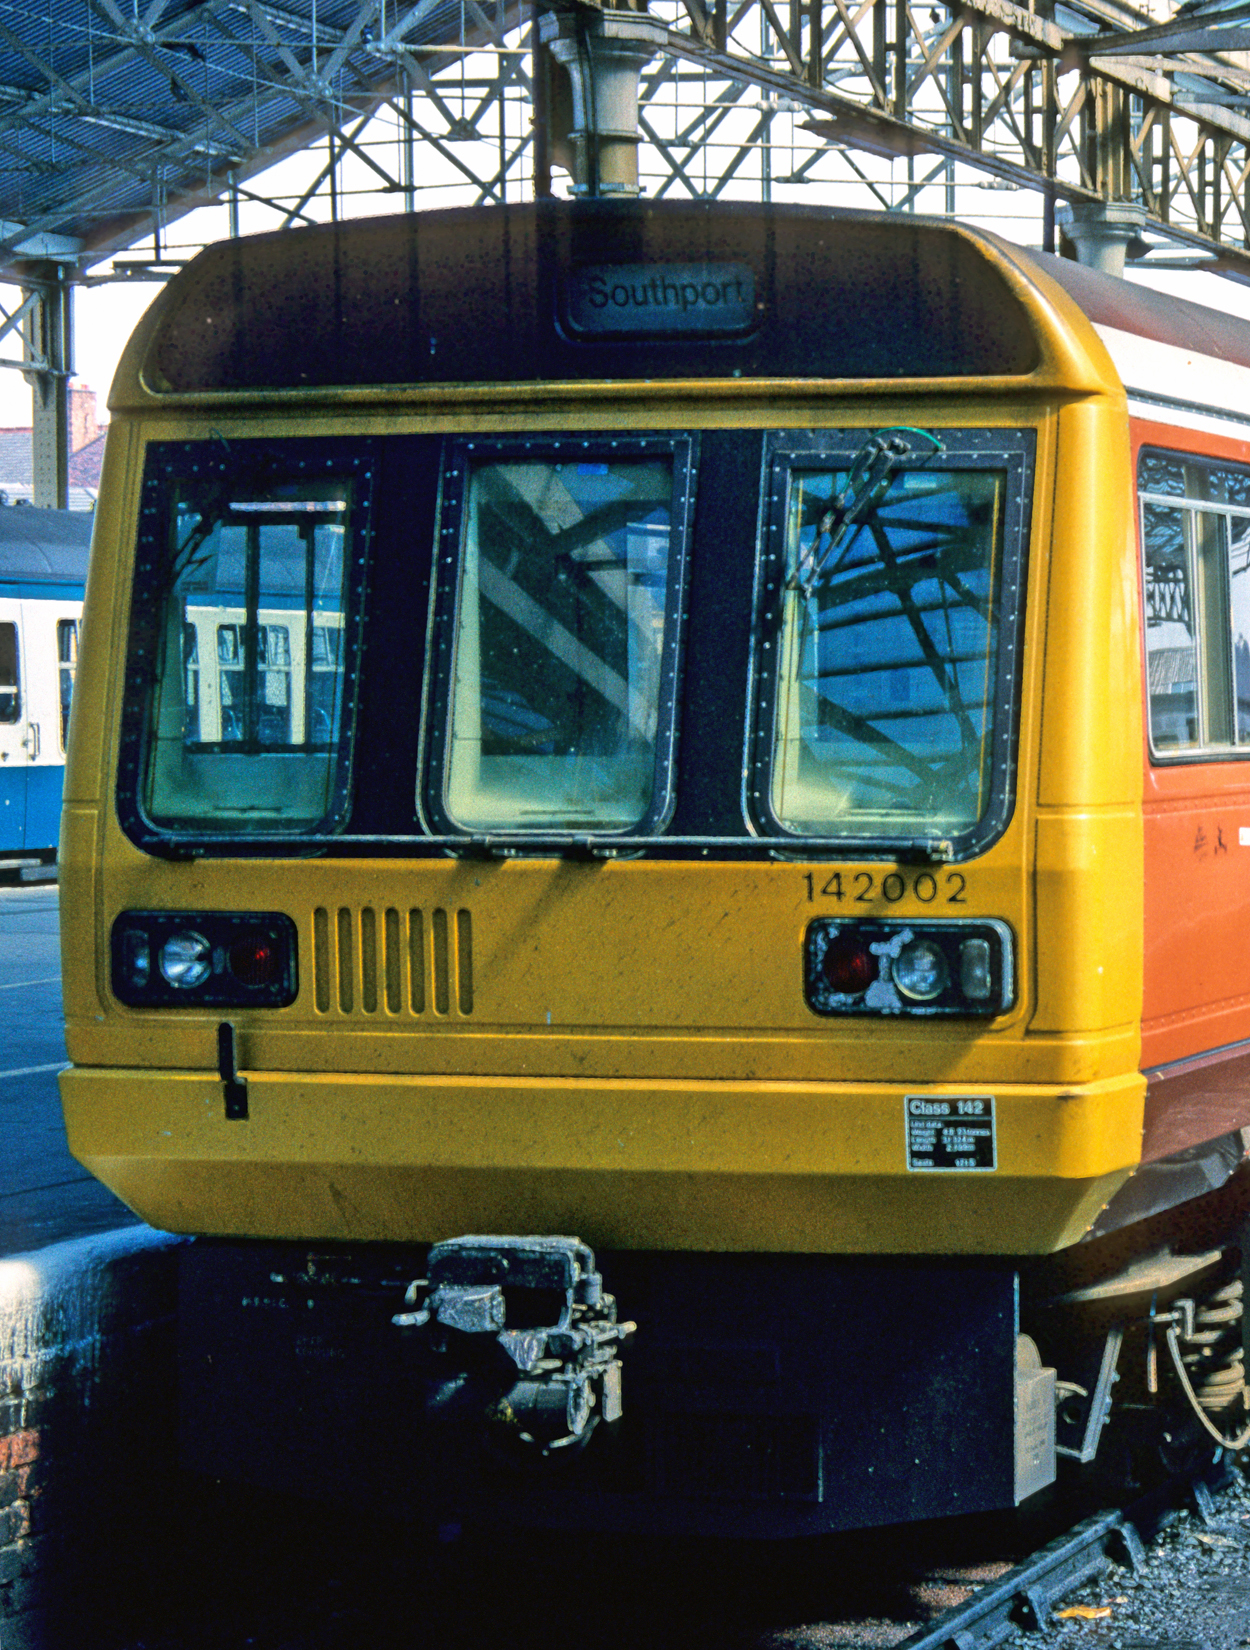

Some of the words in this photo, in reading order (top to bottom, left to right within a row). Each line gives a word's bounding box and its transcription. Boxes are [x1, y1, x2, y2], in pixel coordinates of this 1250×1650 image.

[589, 275, 745, 312] Southport
[802, 872, 967, 904] 142002
[910, 1100, 950, 1115] Class
[956, 1100, 985, 1115] 142
[911, 1128, 936, 1136] Weight
[911, 1136, 937, 1144] Length
